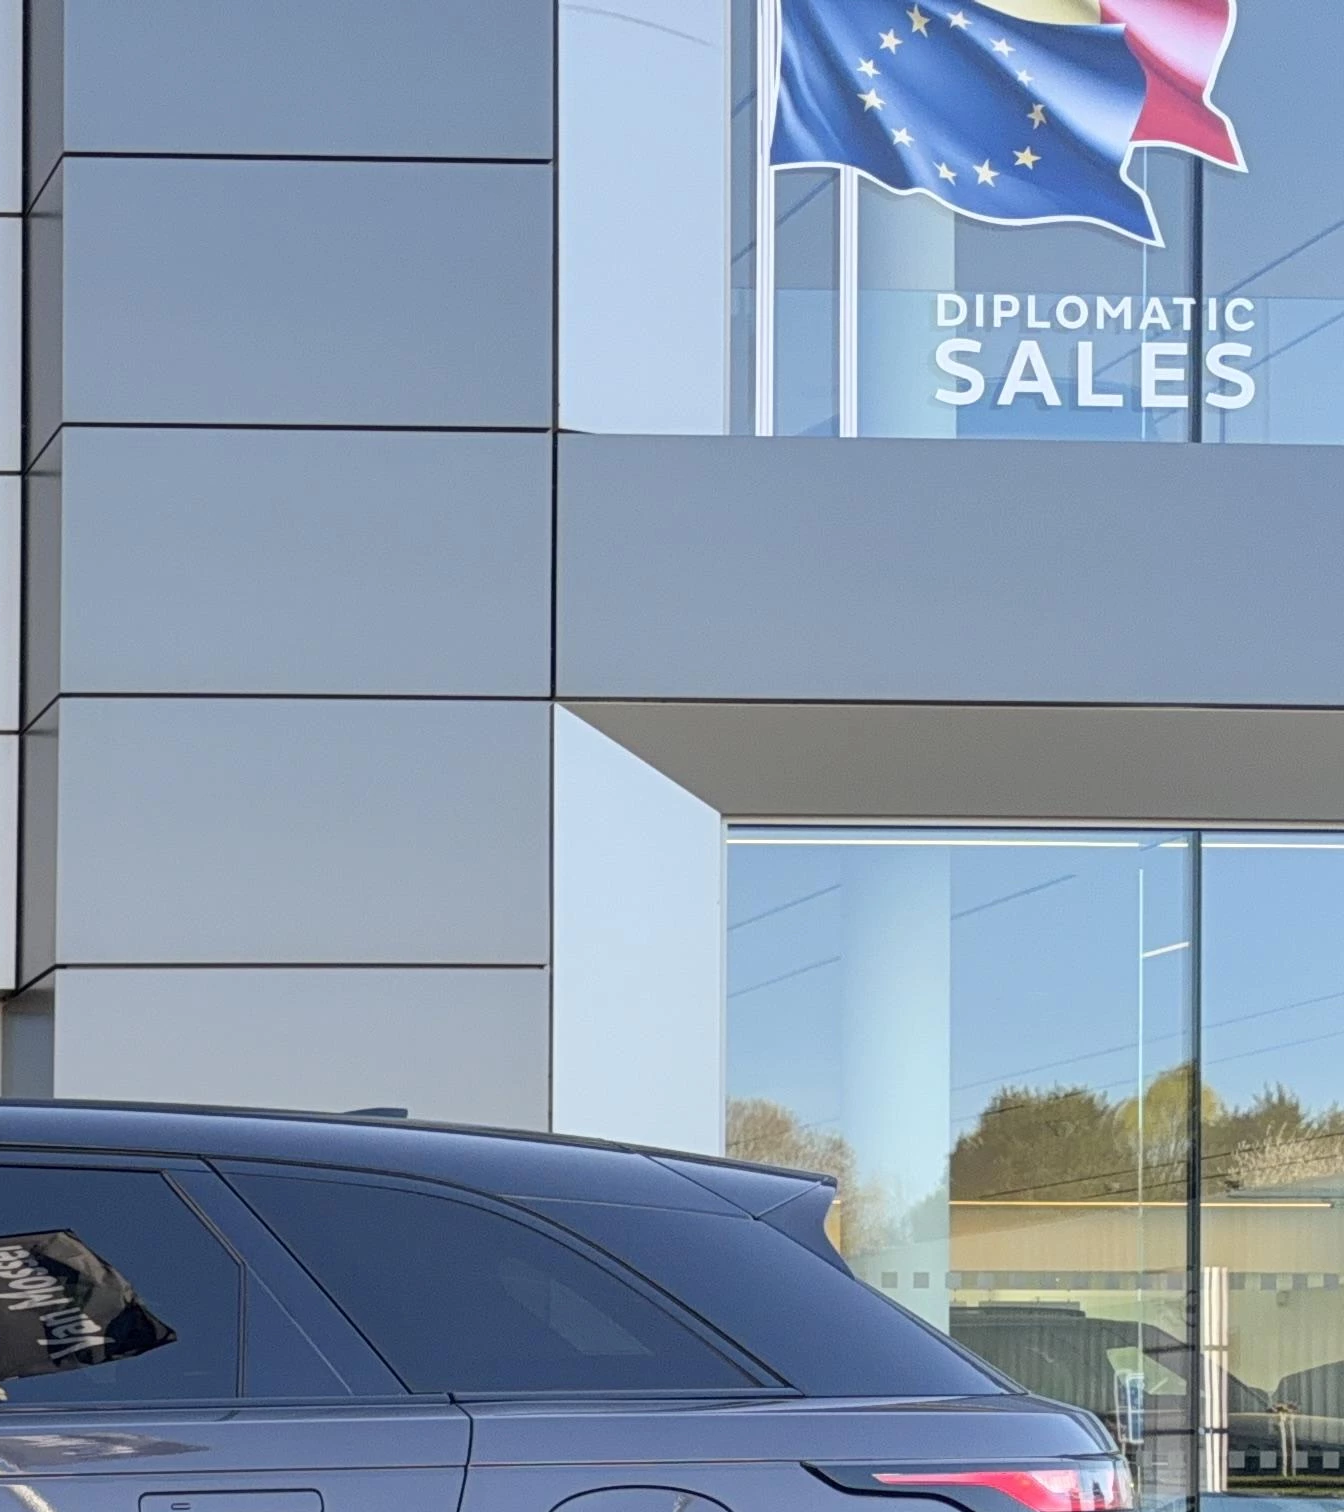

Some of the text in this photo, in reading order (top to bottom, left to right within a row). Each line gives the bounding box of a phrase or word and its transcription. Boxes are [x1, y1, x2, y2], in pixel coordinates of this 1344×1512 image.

[936, 292, 1255, 332] DIPLOMATIC
[934, 338, 1255, 410] SALES
[37, 1307, 115, 1360] Van
